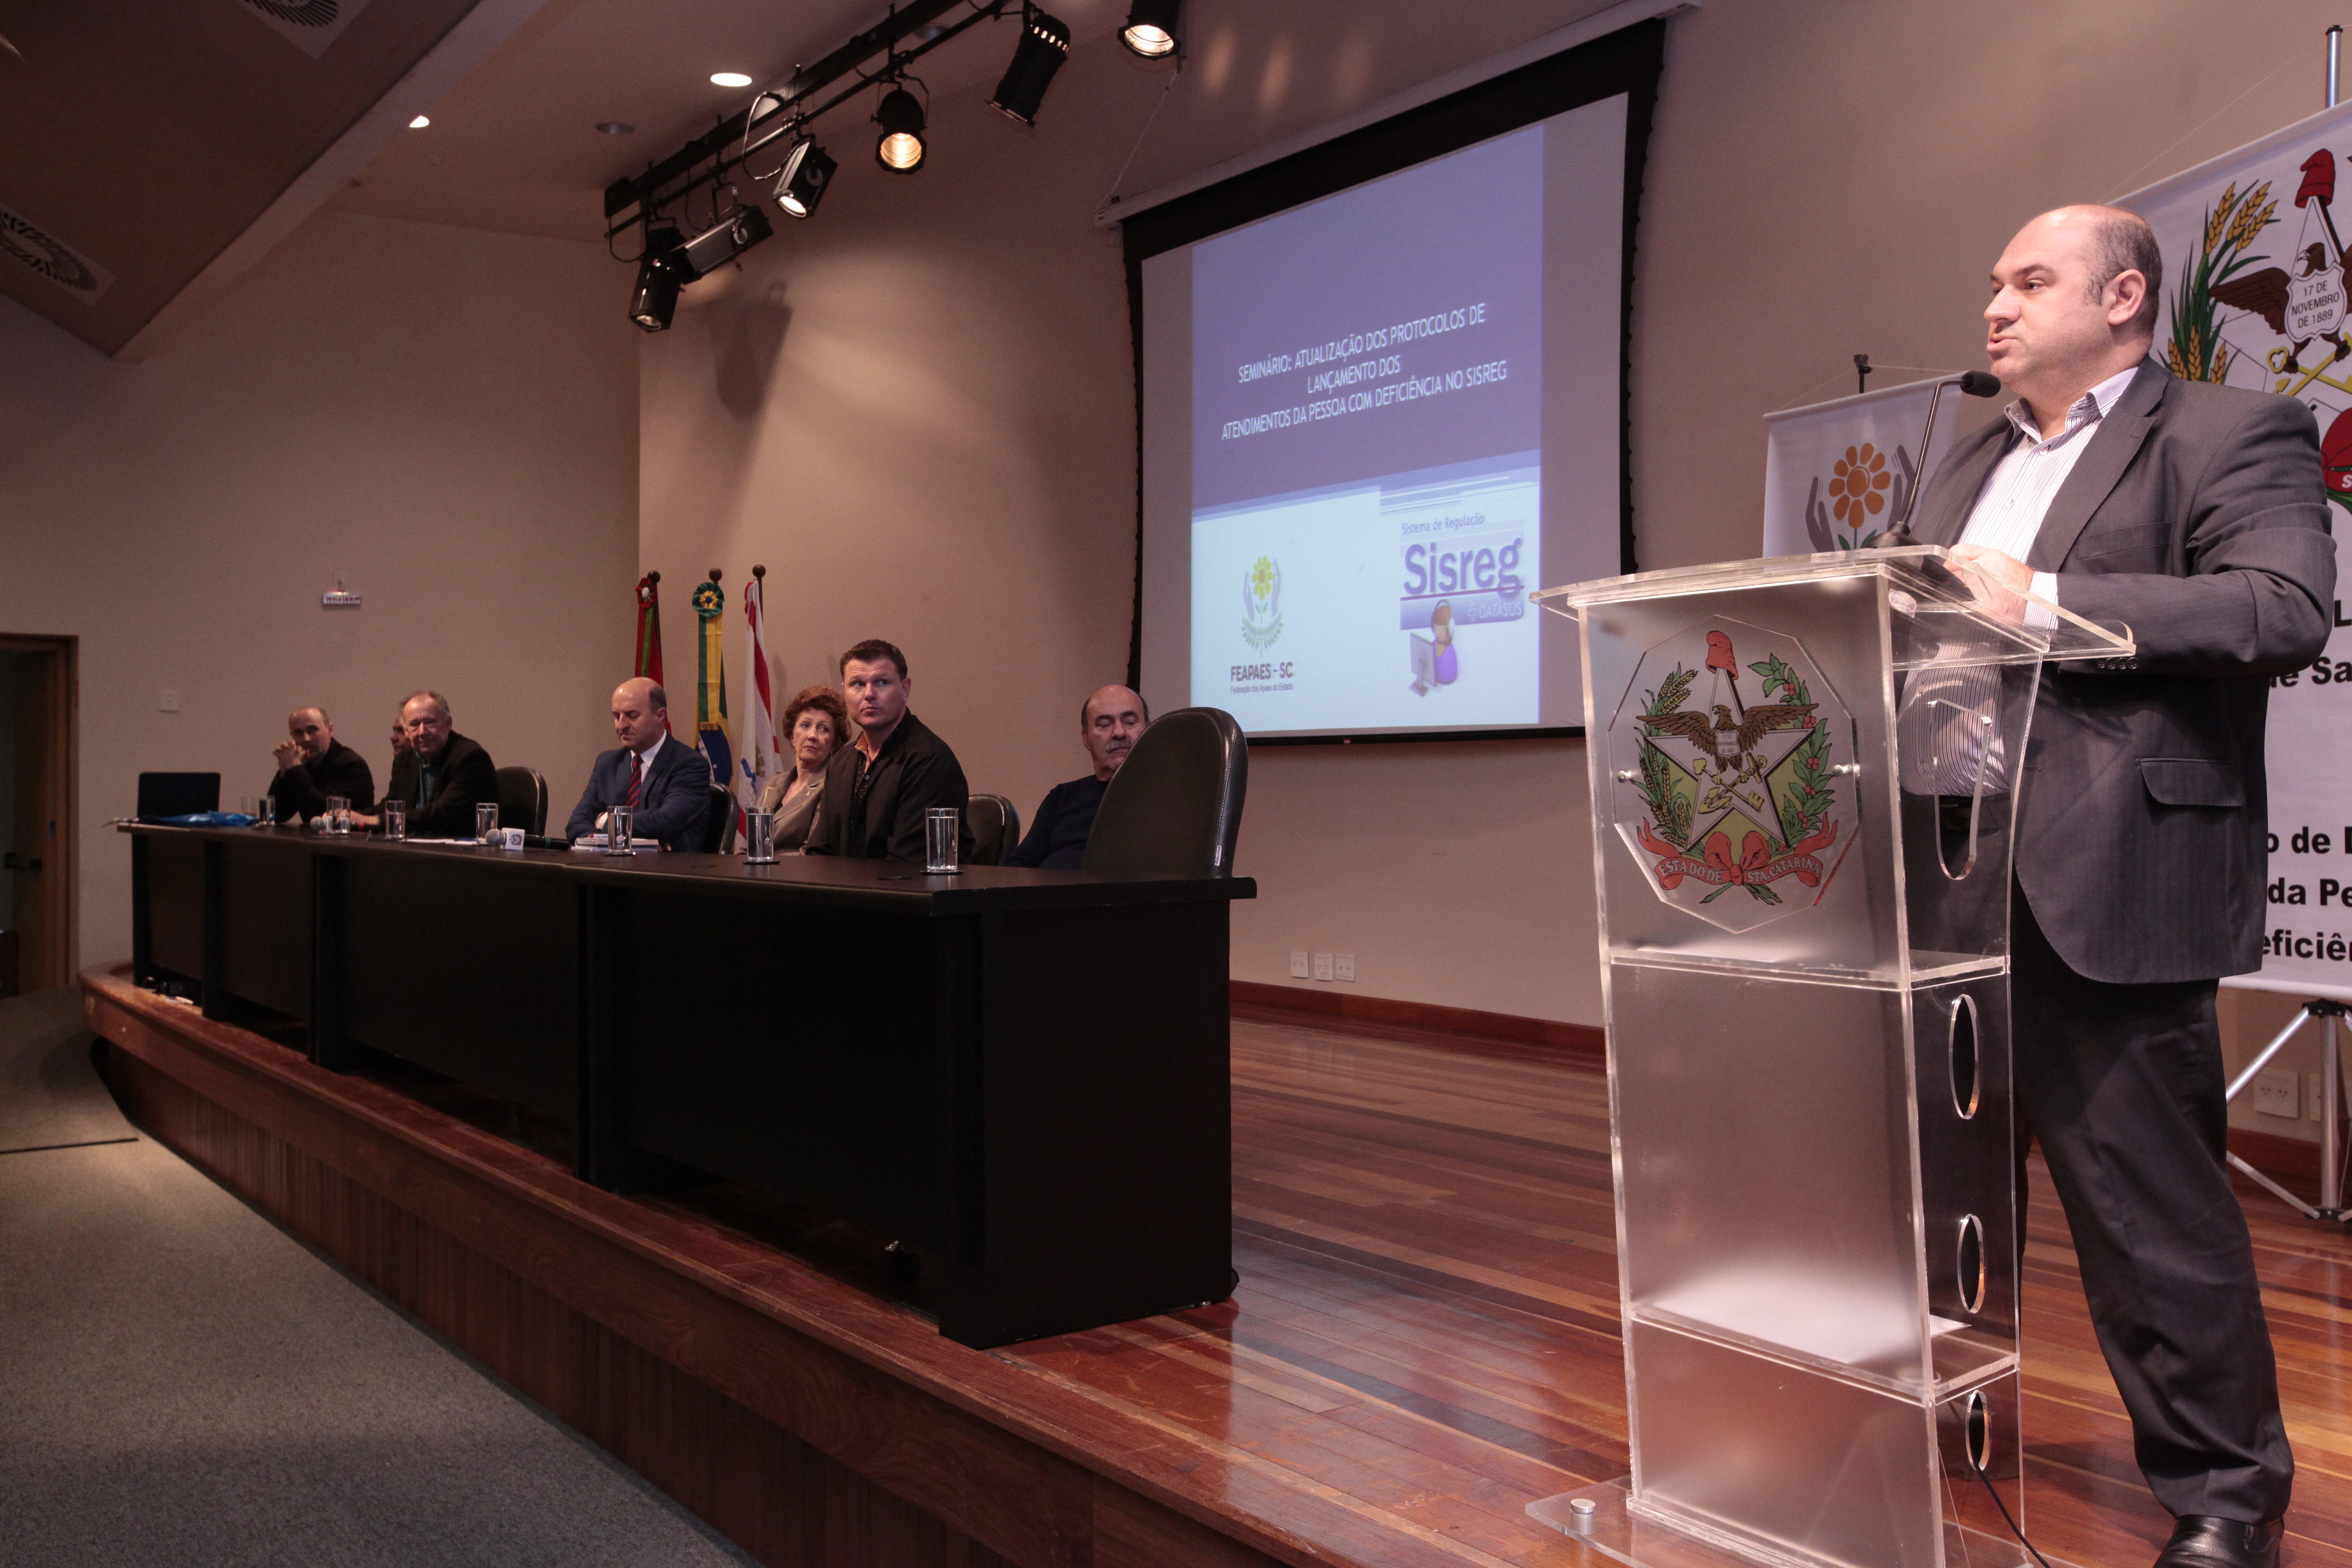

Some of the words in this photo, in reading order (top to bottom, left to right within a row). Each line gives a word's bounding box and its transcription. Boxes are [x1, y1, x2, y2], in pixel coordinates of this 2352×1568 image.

[2304, 285, 2313, 297] 17
[2316, 280, 2327, 293] DE
[2292, 292, 2339, 315] NOVEMBRO
[2298, 316, 2308, 328] DE
[2312, 309, 2333, 324] 1889
[1238, 353, 1291, 383] SEMINÁRIO:
[1294, 334, 1363, 369] ATUALIZAÇÃO
[1366, 329, 1387, 351] DOS
[1390, 308, 1465, 345] PROTOCOLOS
[1469, 303, 1486, 325] DE
[1308, 361, 1376, 395] LANÇAMENTO
[1379, 355, 1401, 377] DOS
[1222, 409, 1291, 441] ATENDIMENTOS
[1293, 405, 1307, 425] DA
[1309, 398, 1346, 421] PESSOA
[1349, 391, 1373, 412] COM
[1375, 375, 1443, 407] DEFICIÊNCIA
[1445, 370, 1464, 392] NO
[1466, 360, 1508, 387] SISREG
[1402, 522, 1430, 535] Sistema
[1432, 518, 1442, 531] de
[1445, 513, 1484, 531] Regulação
[1403, 537, 1522, 602] Sisreg
[1479, 602, 1522, 618] DATASUS
[1892, 598, 1913, 609] Caramuru
[1230, 663, 1271, 682] FEAPAES
[1279, 661, 1293, 679] SC
[2291, 826, 2331, 854] de
[1658, 859, 1705, 877] ESTADO
[1706, 869, 1722, 882] DE
[2268, 877, 2306, 905] da
